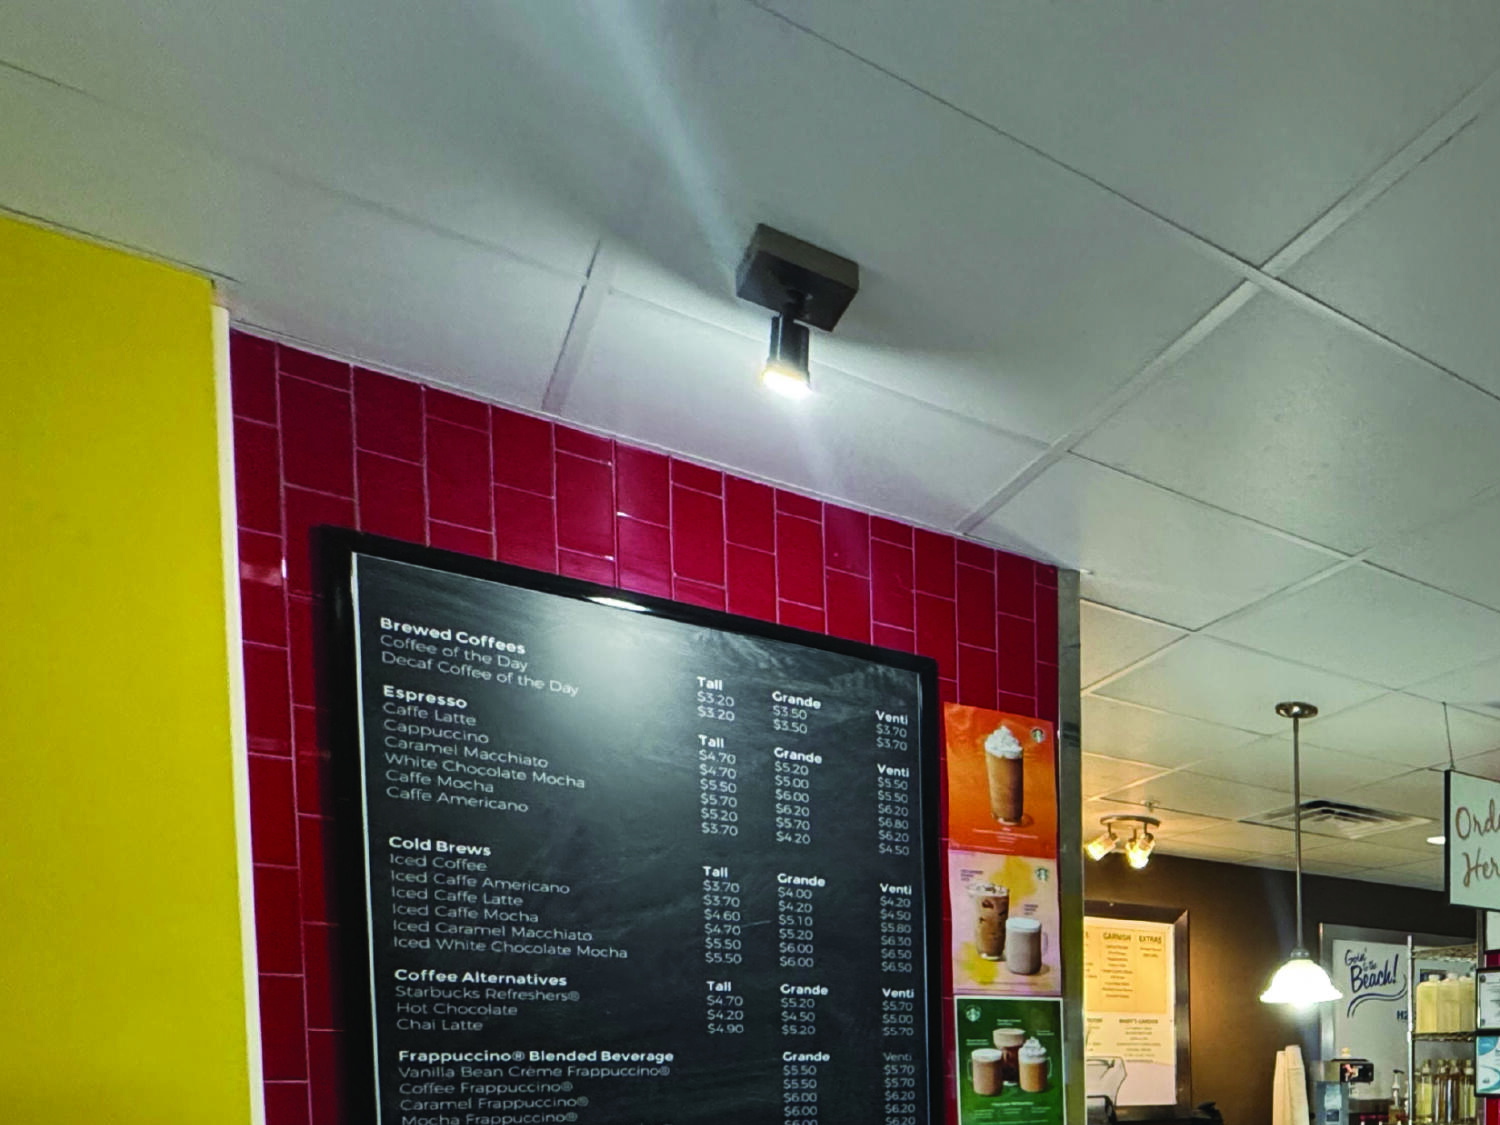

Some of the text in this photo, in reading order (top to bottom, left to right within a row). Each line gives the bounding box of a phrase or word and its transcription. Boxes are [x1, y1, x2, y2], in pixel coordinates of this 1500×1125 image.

[381, 617, 525, 653] Brewed Coffees
[381, 634, 528, 672] Coffee of the Day
[382, 650, 579, 697] Decaf Coffee of the Day
[384, 685, 467, 708] Espresso
[383, 701, 476, 726] Caffe Latte
[384, 719, 489, 743] Cappuccino
[698, 734, 724, 748] Tall
[385, 735, 548, 768] Caramel Macchiato
[699, 748, 736, 764] $4.70
[774, 747, 822, 763] Grande
[385, 752, 584, 788] White Chocolate Mocha
[775, 760, 809, 776] $5.20
[877, 763, 909, 777] Venti
[386, 769, 493, 793] Caffe Mocha
[878, 776, 908, 791] $5.50
[386, 786, 528, 812] Caffe Americano
[389, 836, 491, 856] Cold Brews
[390, 853, 487, 871] Iced Coffee
[391, 870, 570, 894] Iced Caffe Americano
[394, 919, 592, 941] Iced Caramel Macchiato
[1138, 935, 1162, 944] EXTRAS
[394, 936, 627, 958] Iced White Chocolate Mocha
[395, 968, 567, 986] Coffee Alternatives
[1351, 953, 1399, 993] Beach!
[396, 985, 579, 1001] Starbucks Refreshers®
[397, 1002, 517, 1015] Hot Chocolate
[397, 1018, 483, 1031] Chai Latte
[399, 1050, 673, 1064] Frappuccino® Blended Beverage
[399, 1066, 455, 1078] Vanilla
[461, 1066, 503, 1077] Bean
